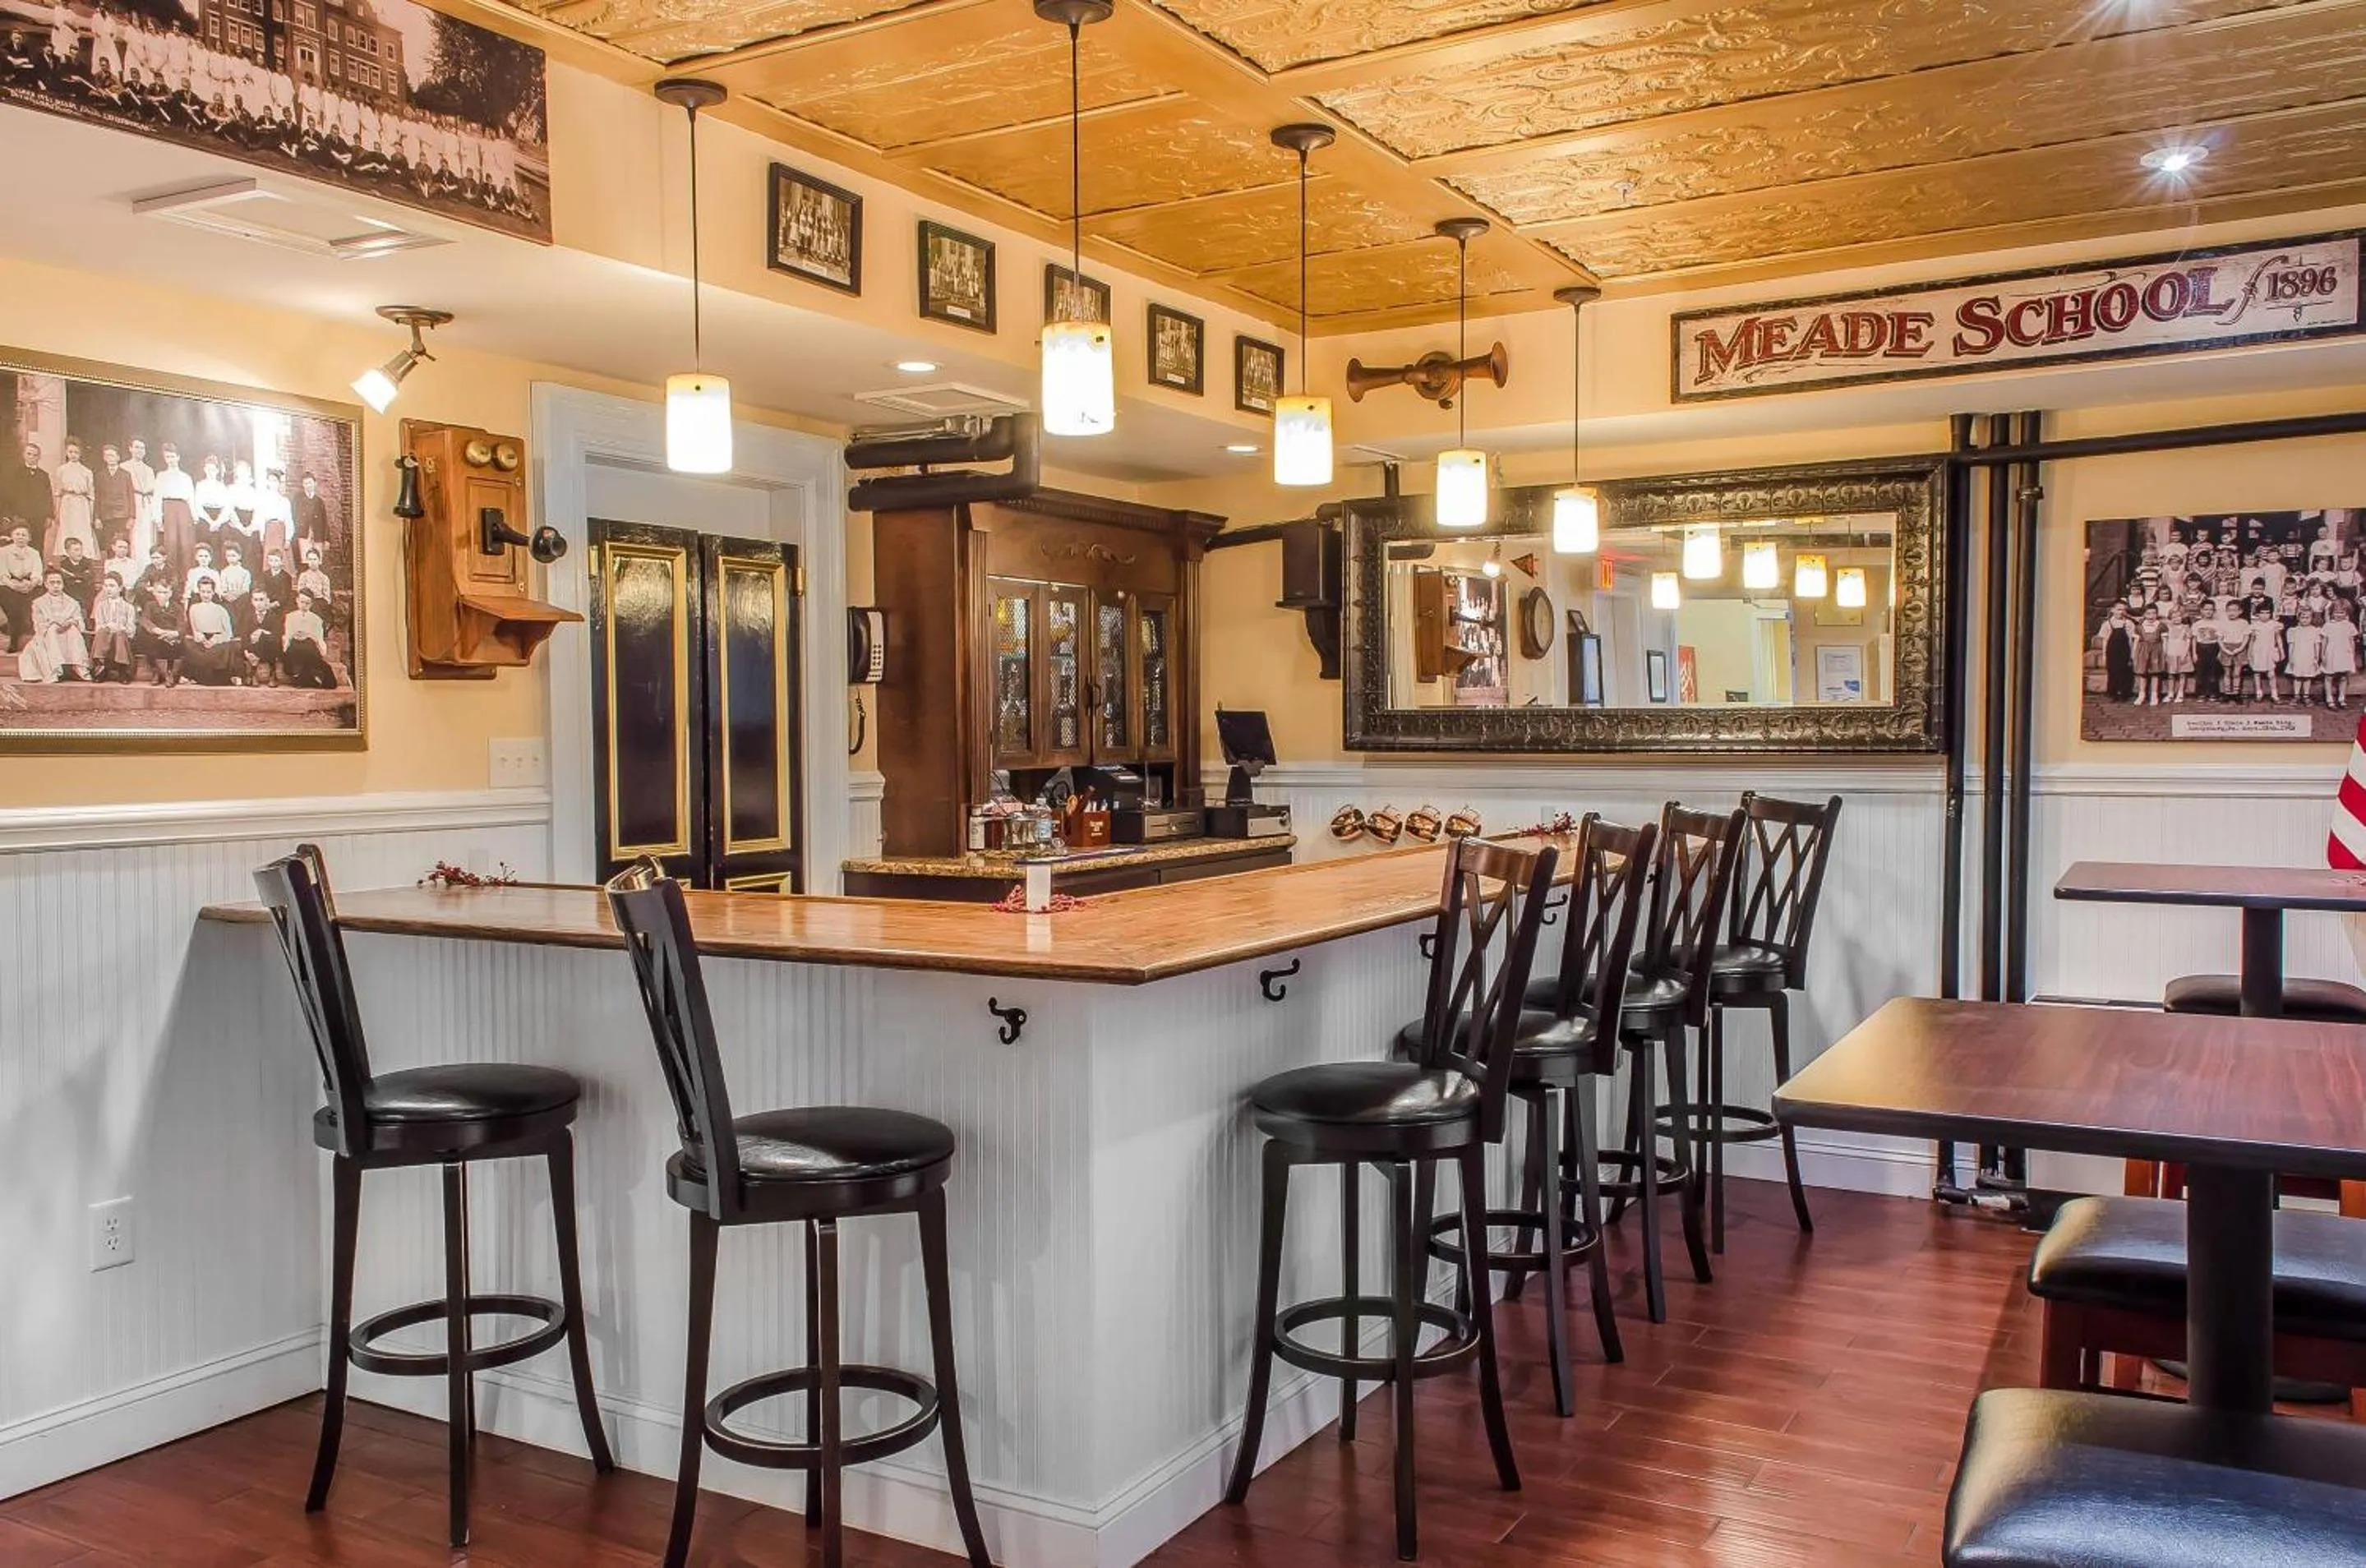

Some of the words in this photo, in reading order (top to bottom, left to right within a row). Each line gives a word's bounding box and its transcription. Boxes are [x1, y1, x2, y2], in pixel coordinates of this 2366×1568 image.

[1694, 311, 1935, 385] MEADE
[1953, 266, 2235, 357] SCHOOL
[2265, 266, 2338, 302] 1896
